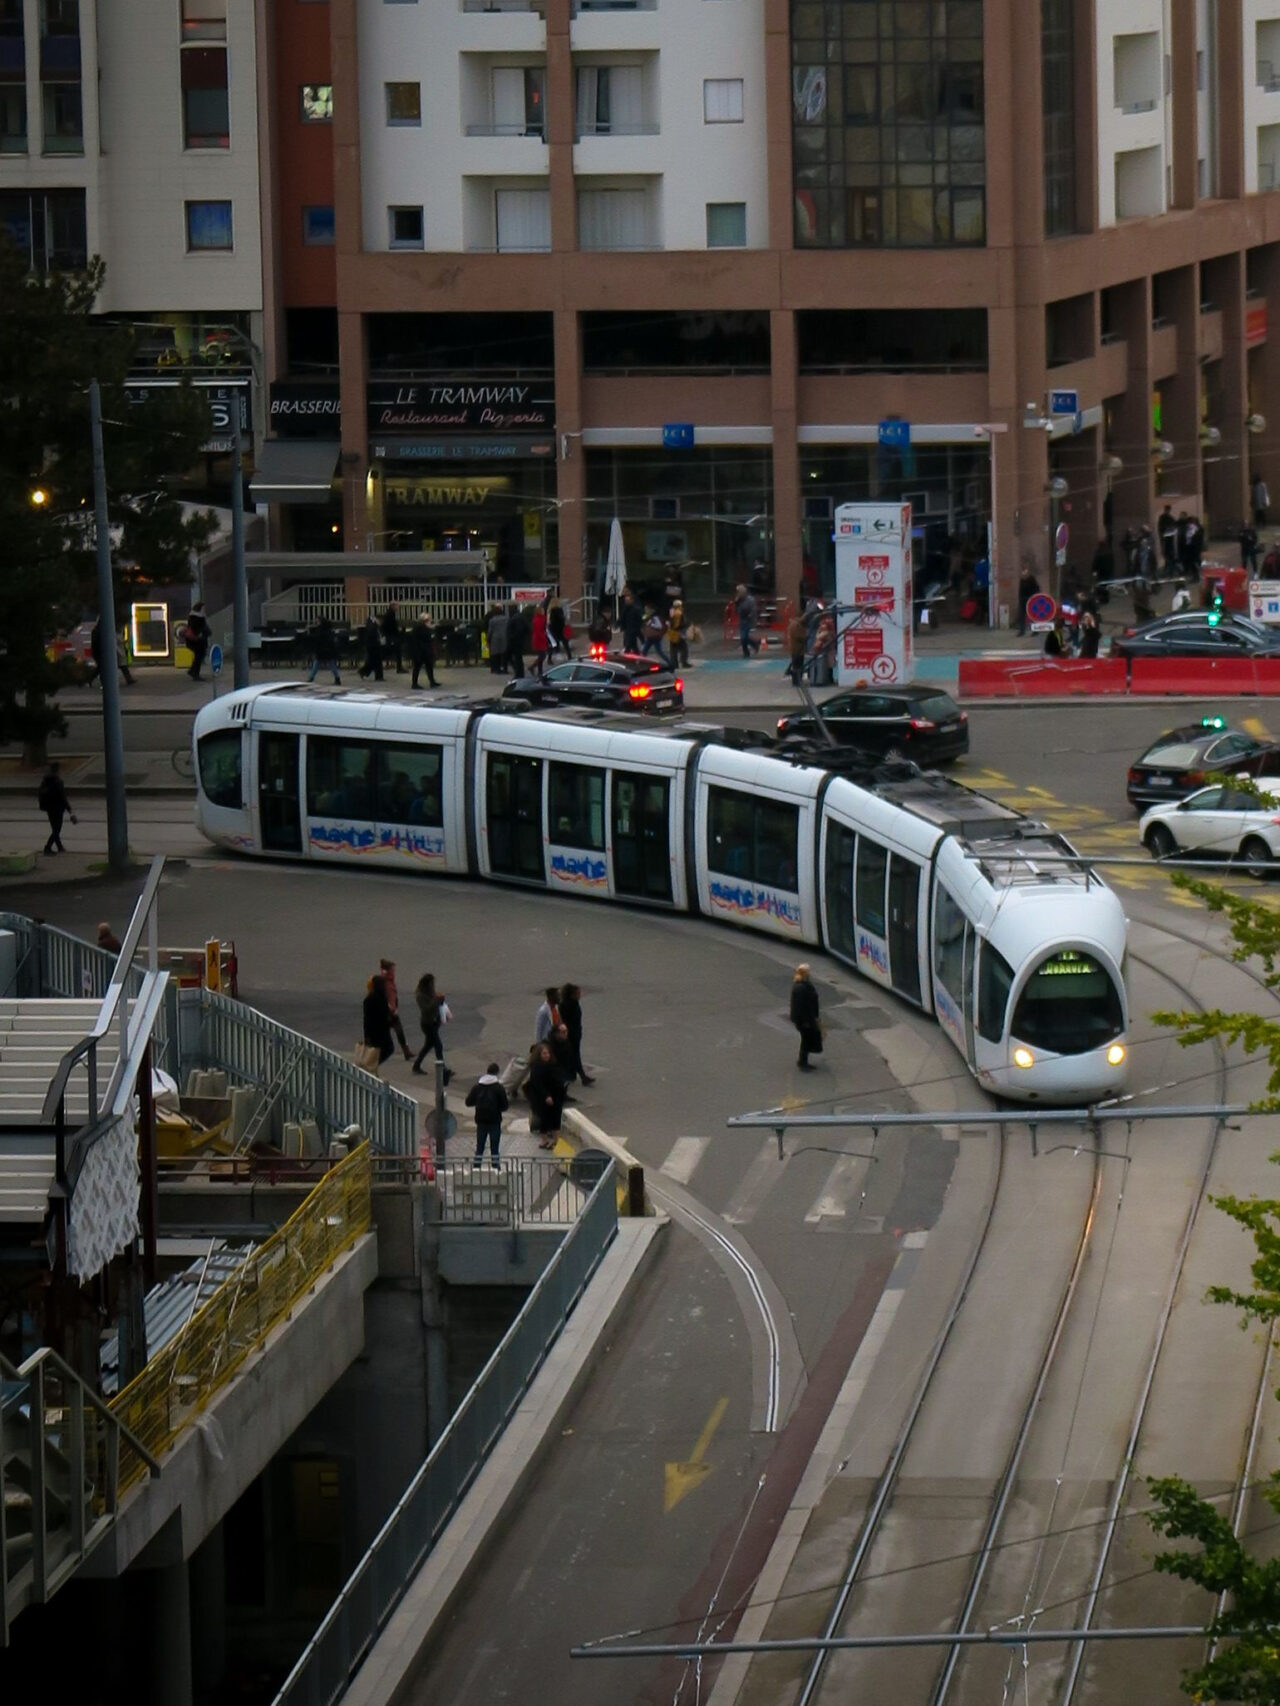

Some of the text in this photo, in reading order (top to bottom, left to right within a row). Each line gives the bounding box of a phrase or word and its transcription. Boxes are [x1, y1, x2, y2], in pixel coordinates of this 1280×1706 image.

[396, 387, 528, 404] LE TRAMWAY
[271, 400, 341, 414] BRASSERIE
[380, 408, 545, 428] Restaurant Pizzeria
[399, 446, 517, 456] BRASSERIE LE TRAMWAY
